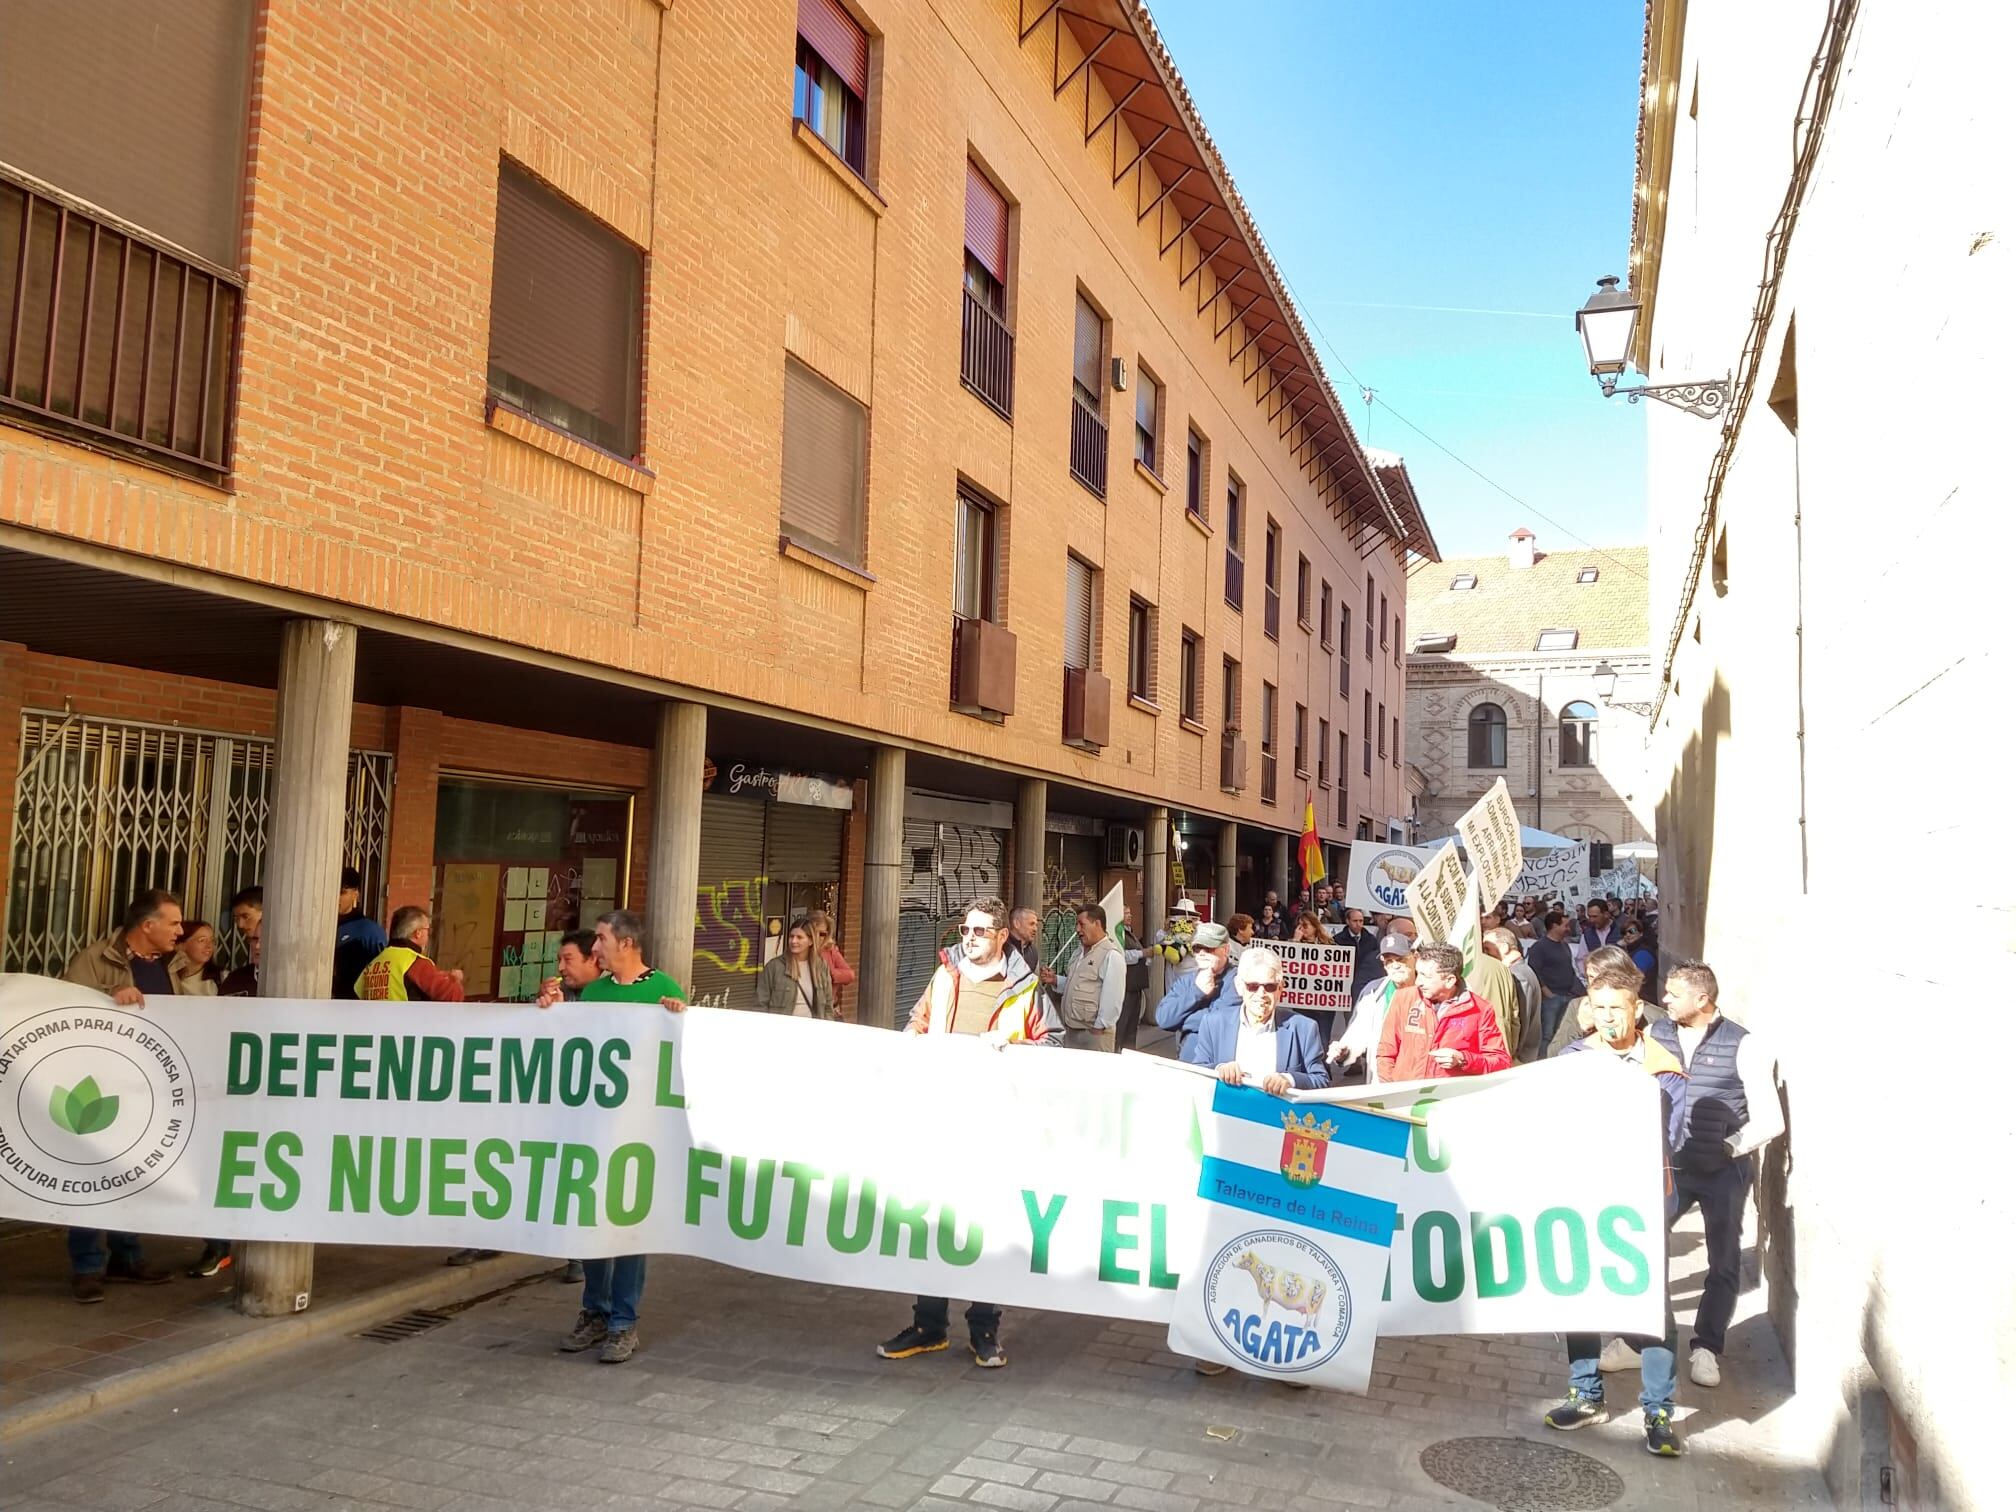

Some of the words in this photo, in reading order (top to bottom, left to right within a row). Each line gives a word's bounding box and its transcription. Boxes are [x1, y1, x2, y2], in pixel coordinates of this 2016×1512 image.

[1466, 820, 1477, 834] MI
[1472, 834, 1497, 905] EXPLOTACIÓN
[1481, 827, 1502, 880] ARRUINAN
[1486, 799, 1513, 884] ADMINISTRACIÓN
[1375, 884, 1409, 907] AGAT
[1282, 976, 1308, 990] STO
[1314, 979, 1344, 992] SON
[1301, 948, 1319, 961] NO
[1324, 949, 1351, 963] SON
[1408, 1007, 1421, 1027] 2
[0, 1019, 71, 1083] LATAFORMA
[74, 1018, 114, 1033] PARA
[117, 1023, 135, 1039] LA
[135, 1032, 180, 1083] DEFENSA
[172, 1087, 184, 1107] DE
[226, 1031, 631, 1109] DEFENDEMOS
[0, 1127, 57, 1190] RICULTURA
[61, 1165, 146, 1193] ECOLÓGICA
[144, 1149, 164, 1168] EN
[160, 1118, 182, 1147] CLM
[214, 1131, 304, 1212] ES
[328, 1134, 655, 1227] NUESTRO
[684, 1146, 984, 1267] FUTURO
[1021, 1190, 1068, 1275] Y
[1098, 1198, 1180, 1291] EL
[1216, 1179, 1281, 1209] Talavera
[1286, 1199, 1306, 1216] de
[1312, 1204, 1326, 1221] la
[1331, 1211, 1379, 1235] Reina
[1210, 1251, 1234, 1304] AGRUPACIÓN
[1231, 1243, 1244, 1255] DE
[1243, 1235, 1295, 1248] GANADEROS
[1296, 1241, 1307, 1252] DE
[1308, 1248, 1340, 1287] TALAVERA
[1332, 1294, 1346, 1339] COMARCA
[1222, 1308, 1321, 1365] AGATA
